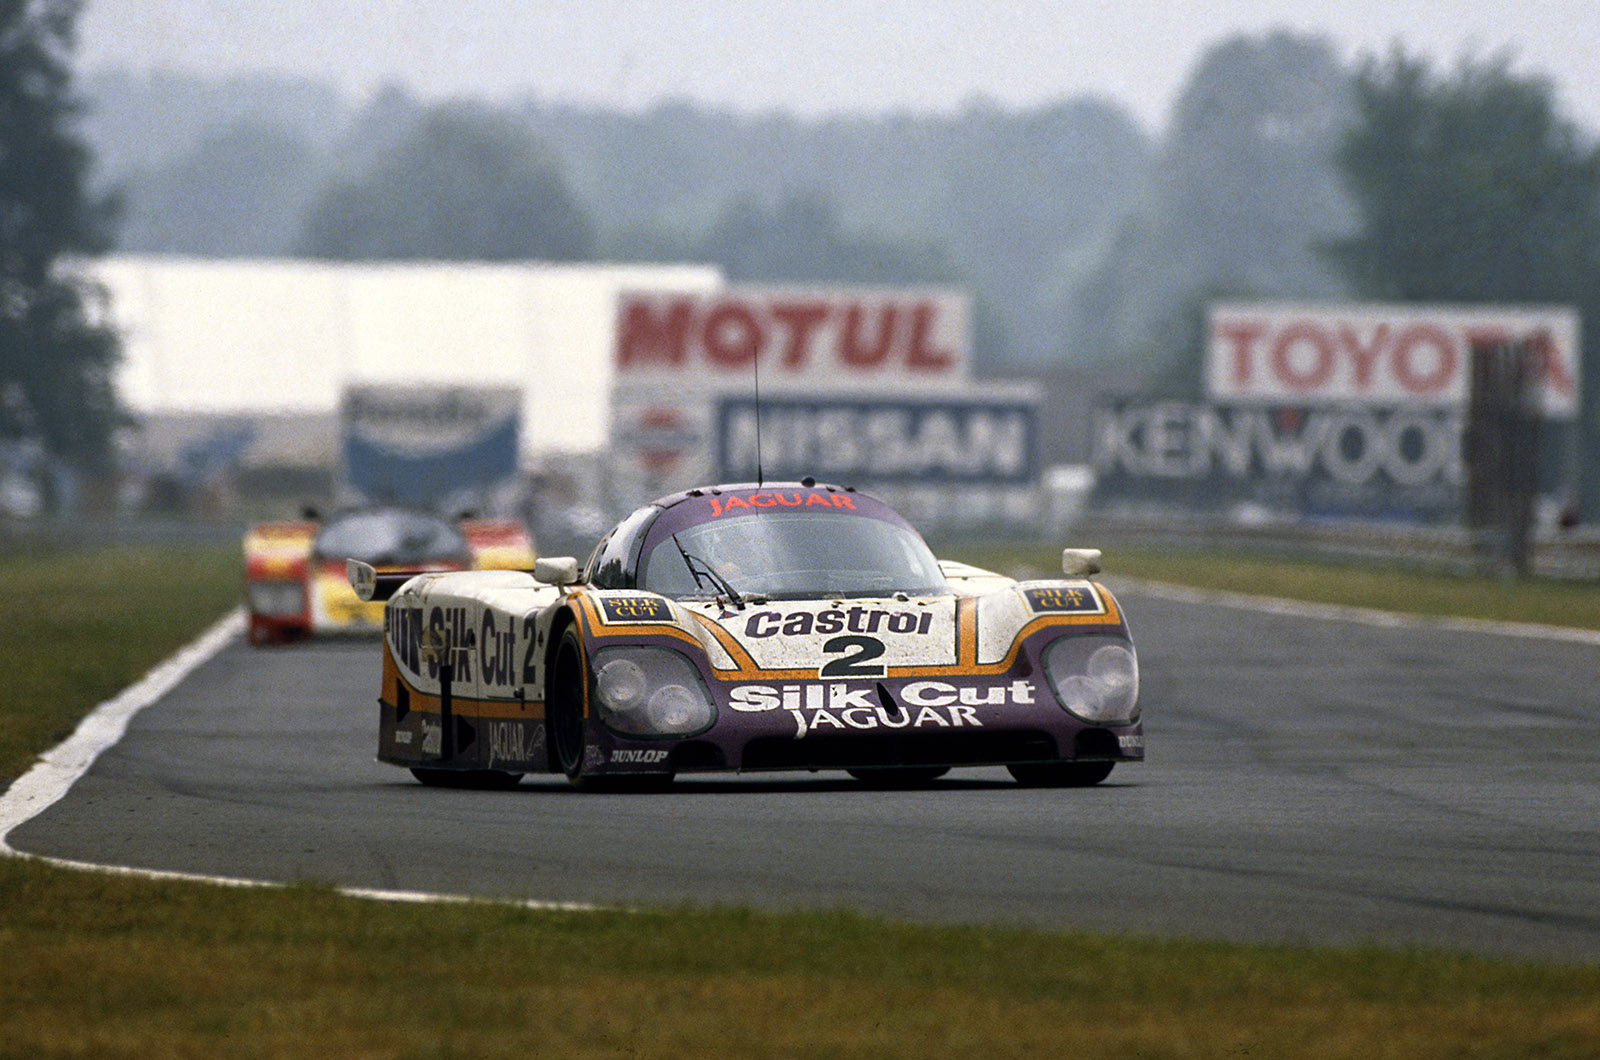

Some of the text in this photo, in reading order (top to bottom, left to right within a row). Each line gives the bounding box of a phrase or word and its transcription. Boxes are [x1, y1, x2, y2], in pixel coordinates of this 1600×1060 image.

[617, 299, 956, 372] MOTUL
[730, 408, 1022, 474] NISSAN
[710, 493, 857, 517] JAGUAR
[1032, 589, 1083, 598] SILK
[1041, 597, 1082, 607] CUT
[615, 607, 658, 616] CUT
[744, 606, 933, 638] Castrol
[427, 606, 475, 683] Silk
[481, 608, 516, 686] Cut
[522, 610, 537, 684] 2
[820, 635, 885, 677] 2
[728, 680, 1035, 711] Silk Cut
[790, 706, 984, 739] JAGUAR
[488, 721, 526, 770] JAGUAR
[610, 750, 669, 763] DUNLOP
